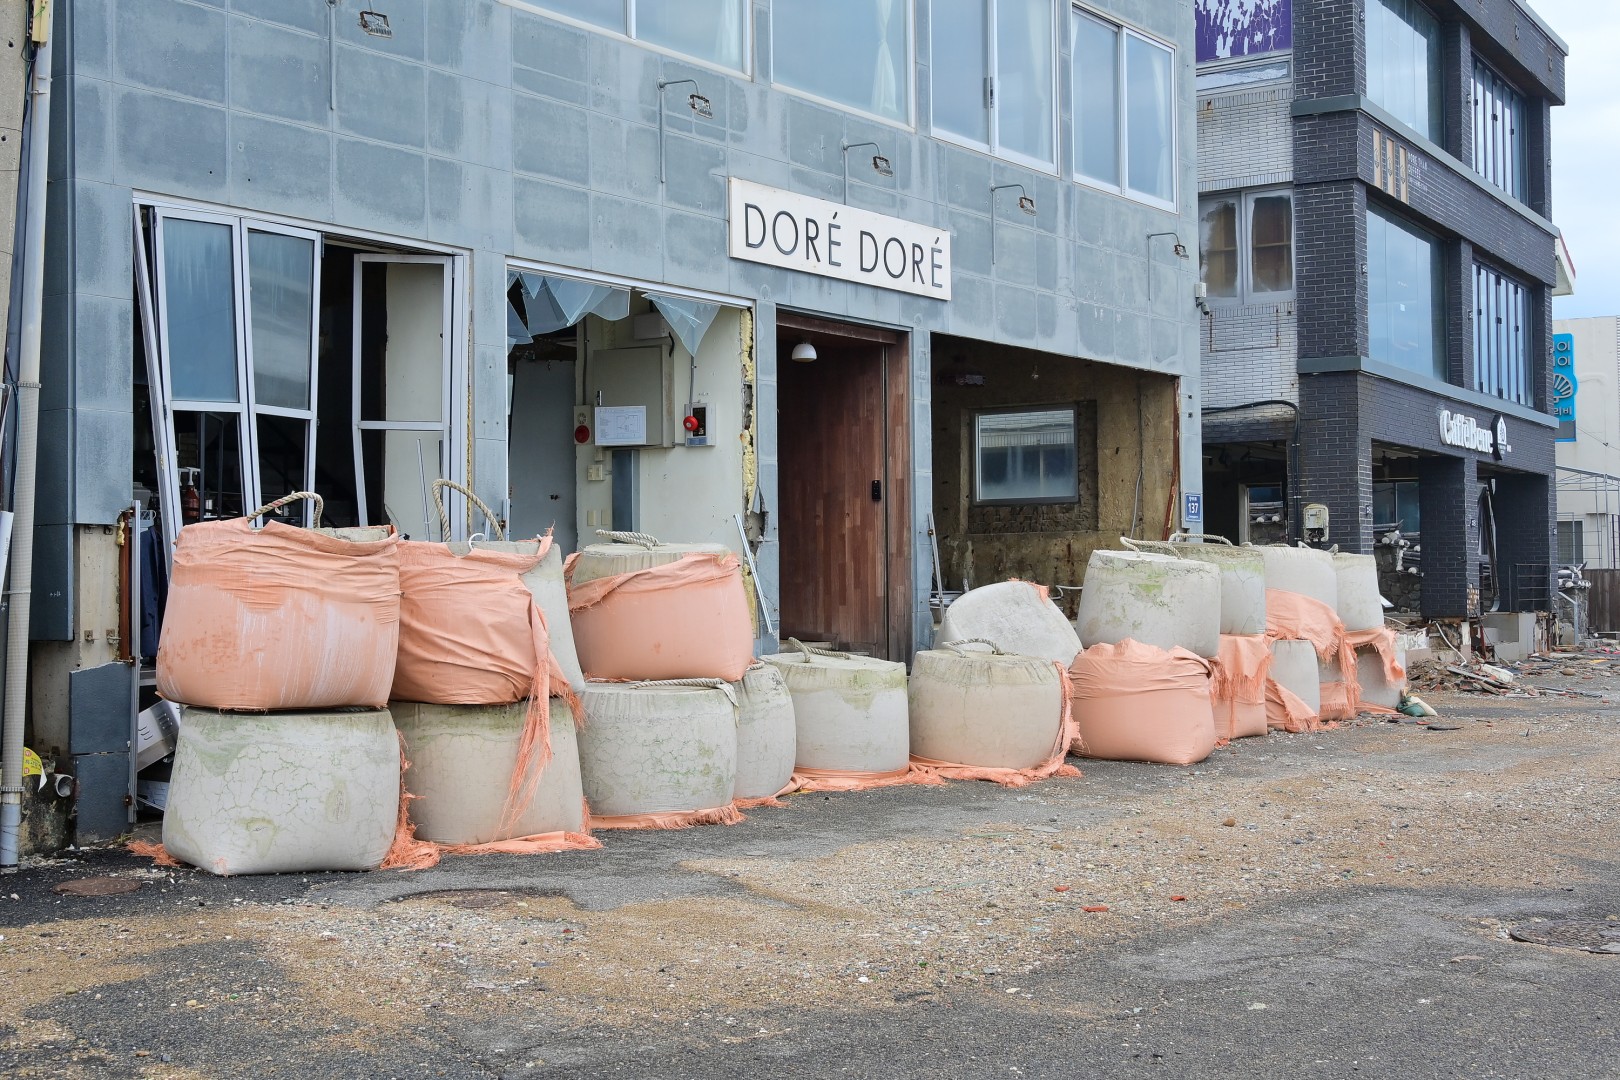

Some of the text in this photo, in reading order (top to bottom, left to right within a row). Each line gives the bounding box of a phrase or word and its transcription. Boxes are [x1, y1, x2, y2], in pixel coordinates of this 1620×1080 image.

[744, 202, 943, 288] DORÉ DORÉ
[1188, 503, 1198, 513] 137
